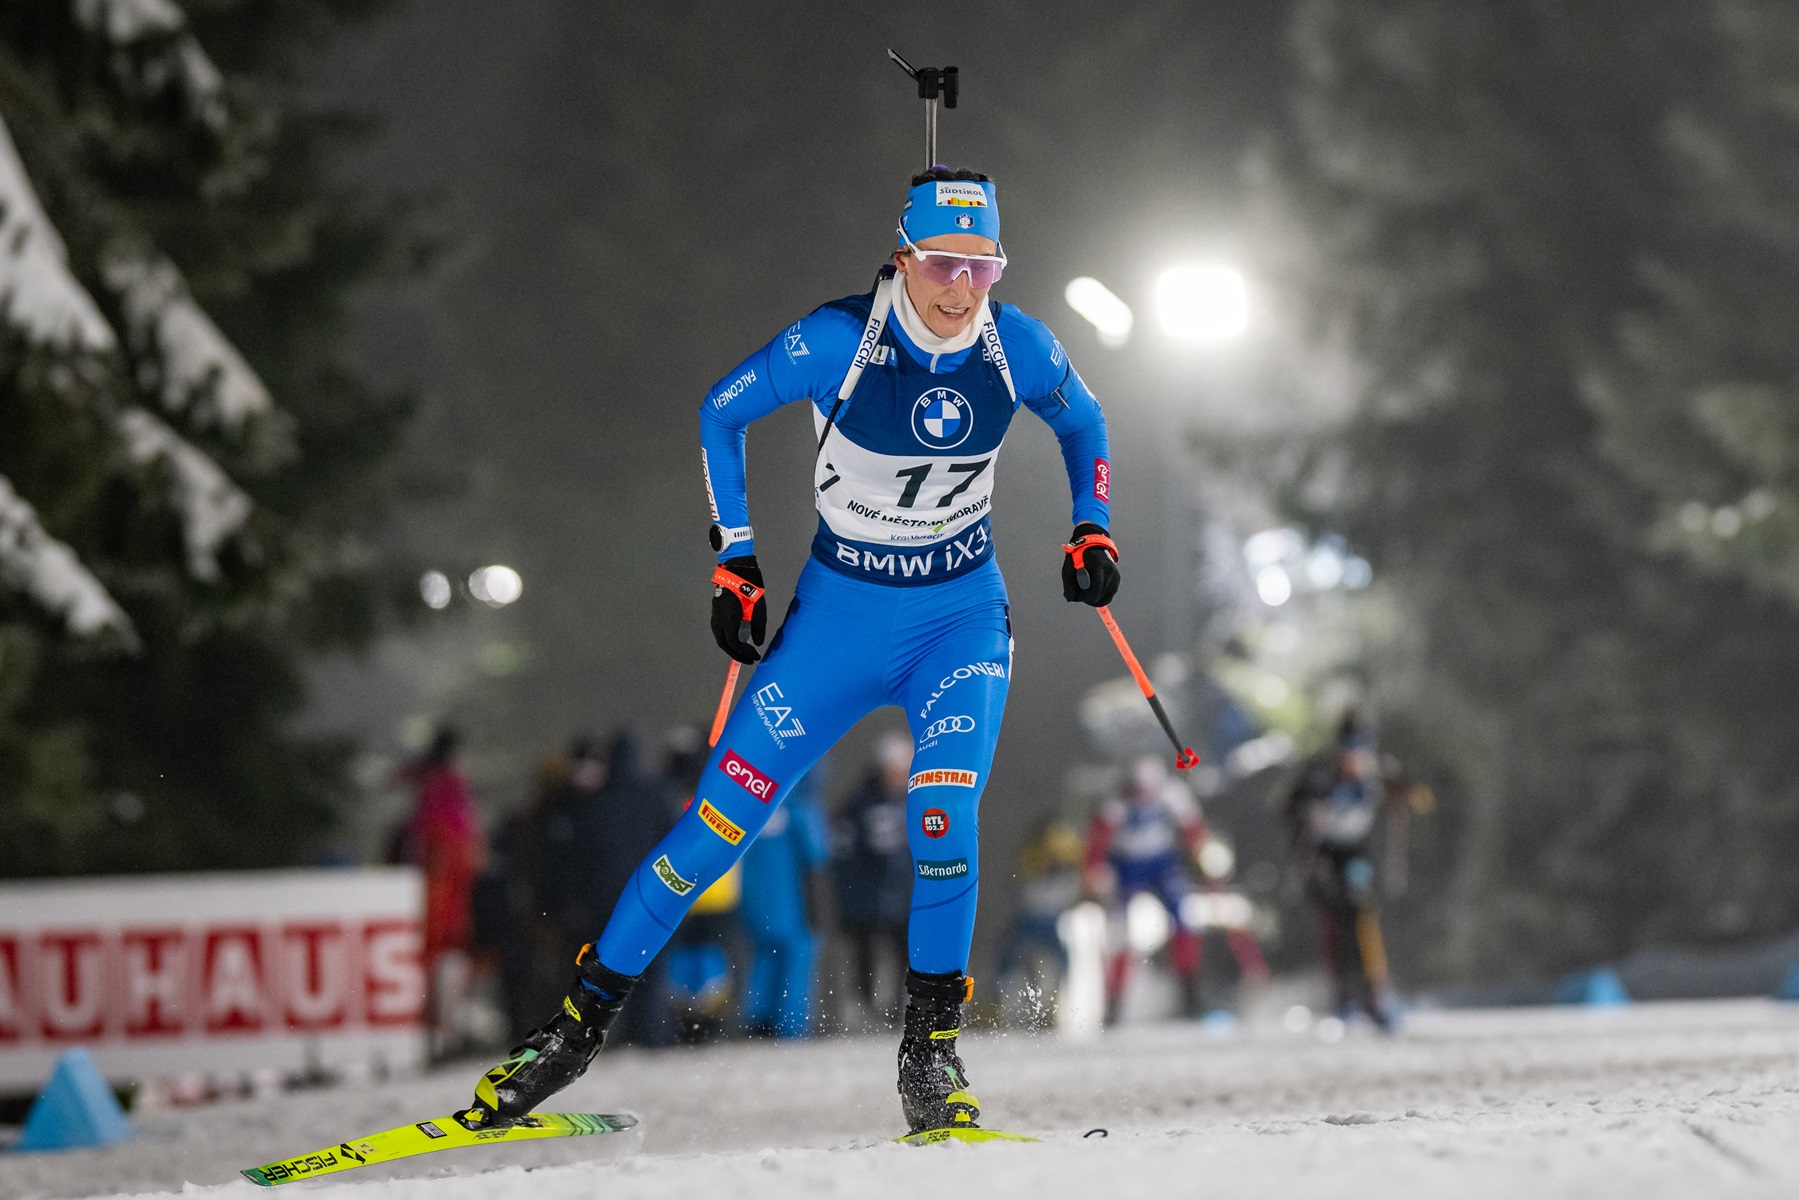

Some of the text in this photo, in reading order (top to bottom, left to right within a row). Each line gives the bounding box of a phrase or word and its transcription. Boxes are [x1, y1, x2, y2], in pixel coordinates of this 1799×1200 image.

[787, 320, 810, 357] EA7
[853, 318, 881, 370] FIOCCHI
[983, 321, 1007, 371] FIOCCHI
[713, 369, 757, 411] FALCONERI
[920, 390, 964, 408] BMW
[895, 457, 992, 509] 17
[1096, 464, 1109, 499] enel
[847, 500, 881, 519] NOVÉ
[836, 523, 988, 578] BMW iX3
[919, 661, 1006, 720] FALCONERI
[756, 681, 806, 738] EA7
[767, 724, 786, 751] ARMANI
[916, 740, 938, 753] Audi
[725, 759, 773, 799] enel
[914, 770, 974, 786] FINSTRAL
[701, 804, 741, 842] PIRELLI
[924, 816, 945, 825] RTL
[655, 856, 694, 894] FORST
[928, 1130, 950, 1142] FISCHER
[258, 1152, 339, 1182] FISCHER
